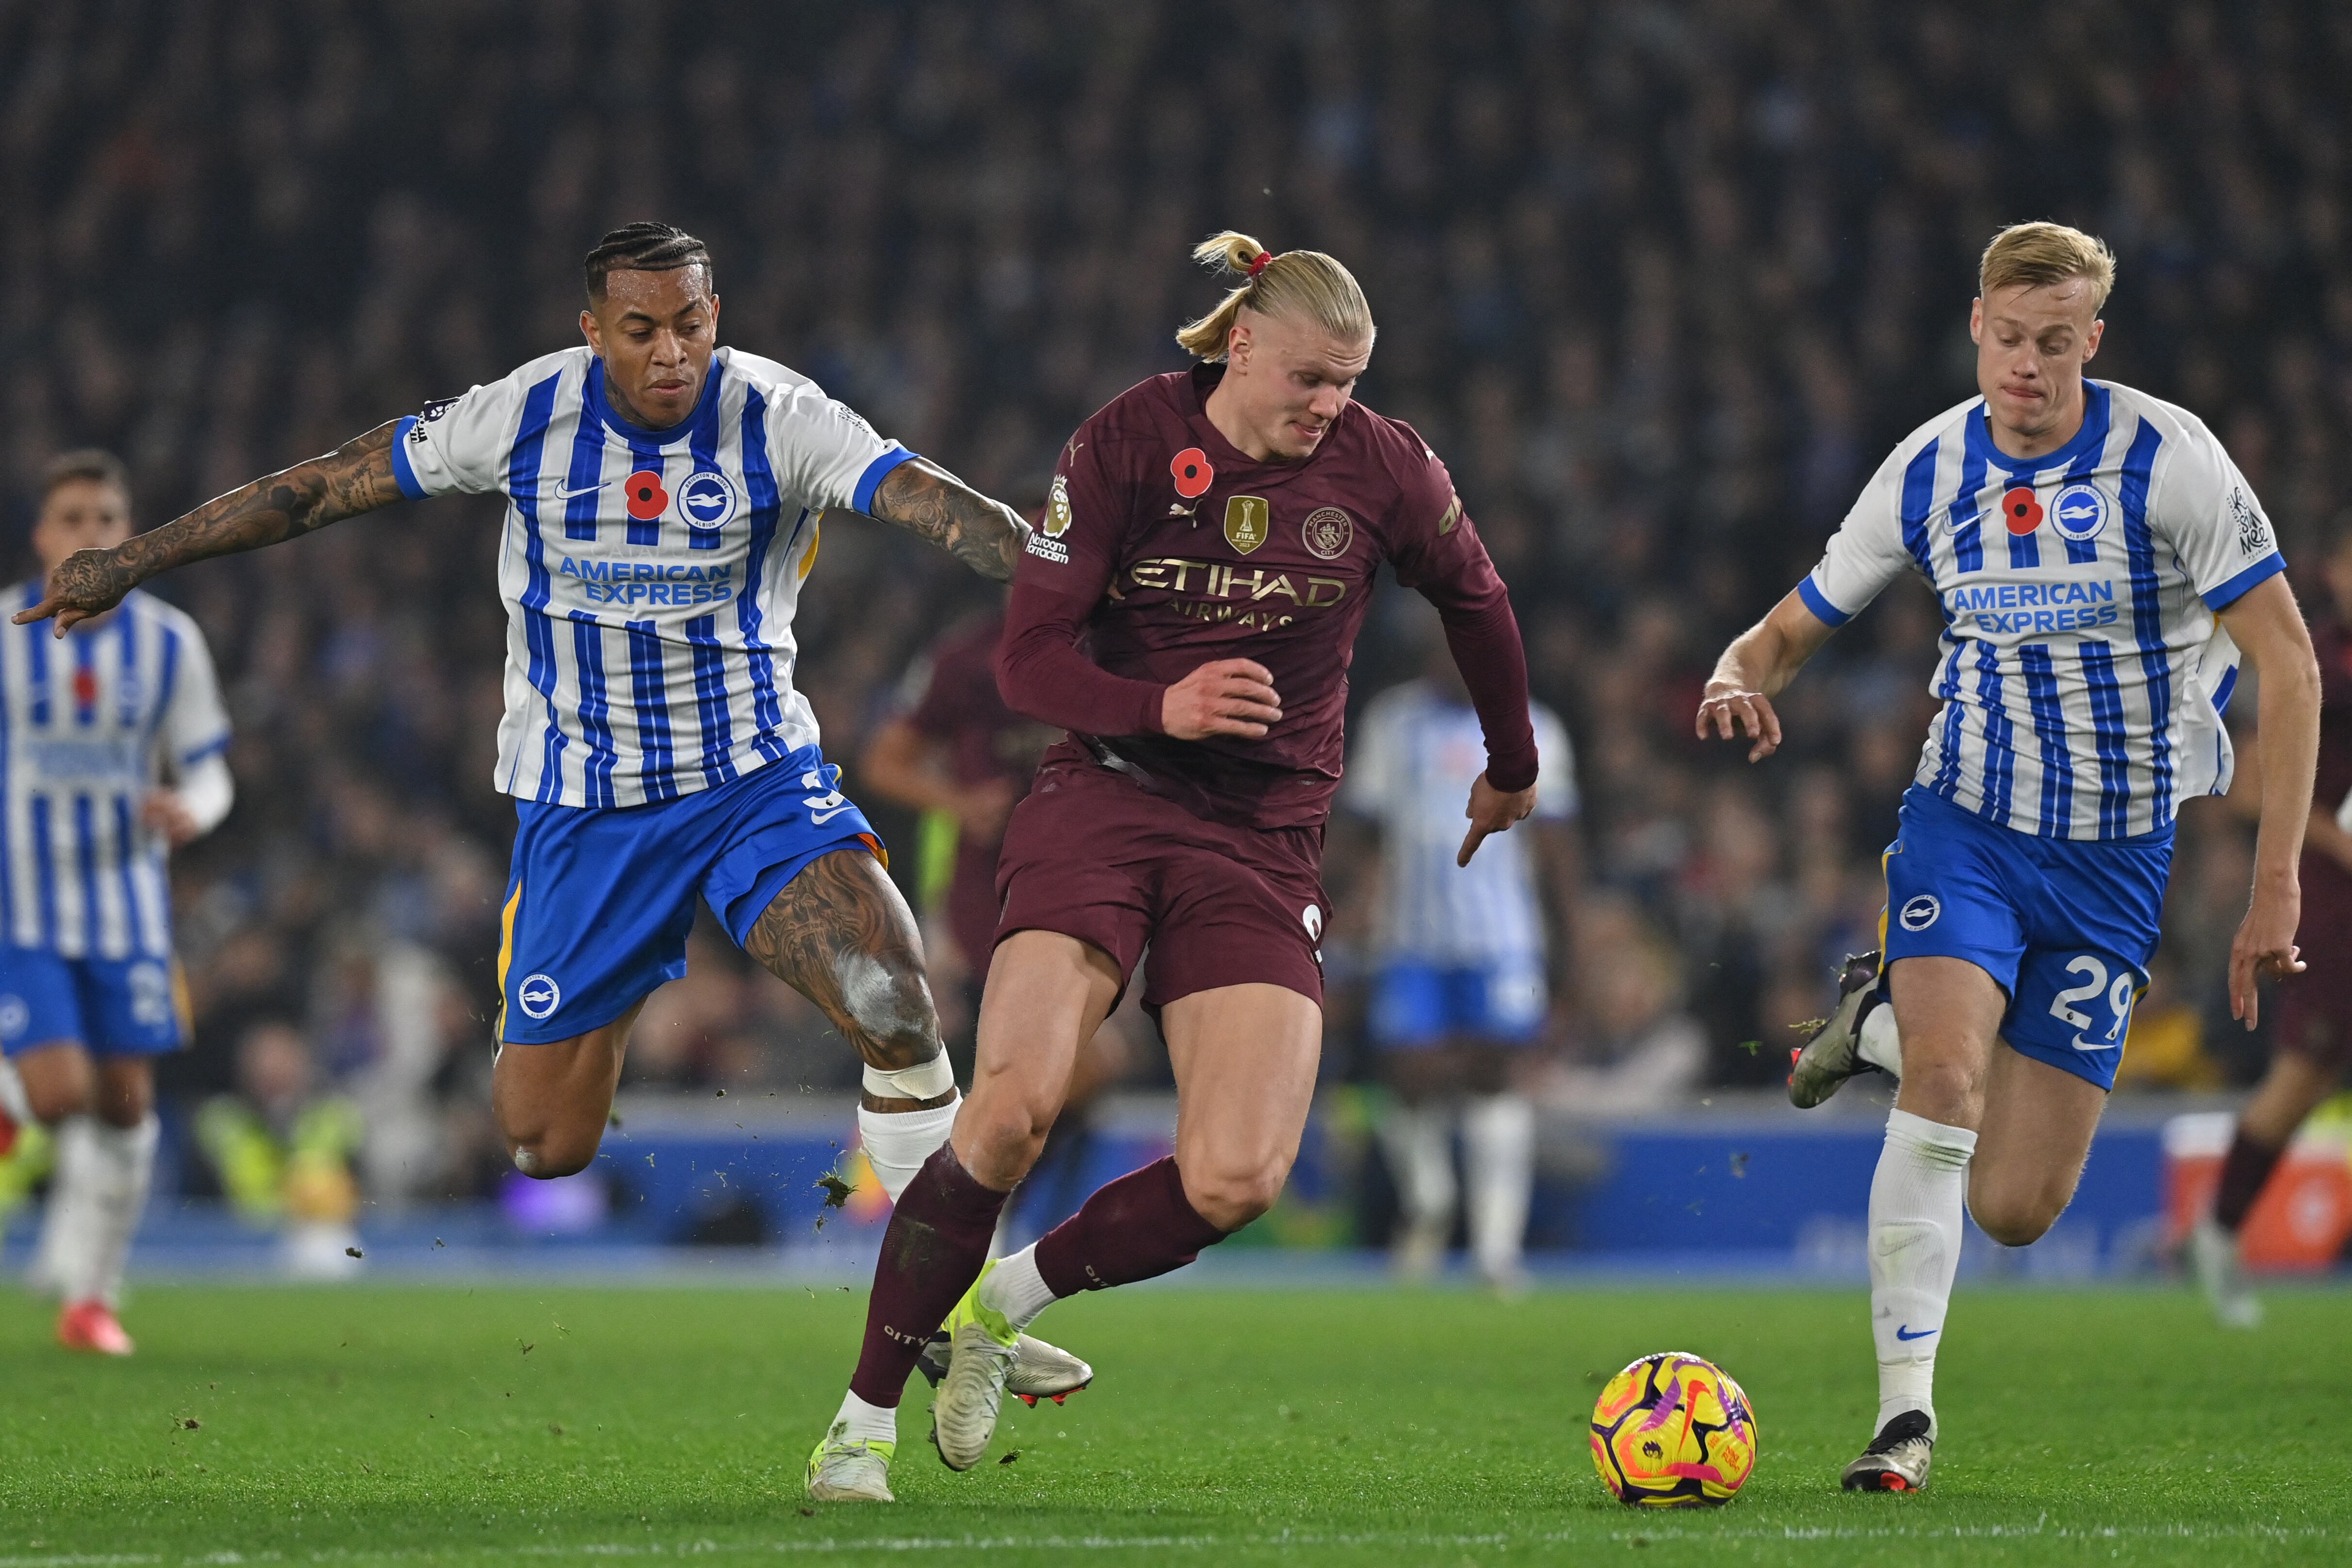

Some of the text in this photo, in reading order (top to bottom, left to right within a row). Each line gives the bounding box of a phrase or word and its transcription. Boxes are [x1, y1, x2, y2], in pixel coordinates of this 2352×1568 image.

[685, 473, 709, 489] BRIGHTON
[717, 477, 729, 490] HOVE
[2057, 487, 2081, 502] BRIGHTON
[1308, 511, 1347, 527] MANCHESTER
[1029, 532, 1067, 554] No room
[1236, 532, 1255, 540] FIFA
[560, 556, 732, 582] AMERICAN
[584, 580, 732, 605] EXPRESS
[1130, 558, 1346, 607] ETIHAD
[1954, 580, 2113, 611] AMERICAN
[1975, 604, 2118, 634] EXPRESS
[522, 975, 540, 988] BRIGHTON
[2049, 955, 2134, 1041] 29
